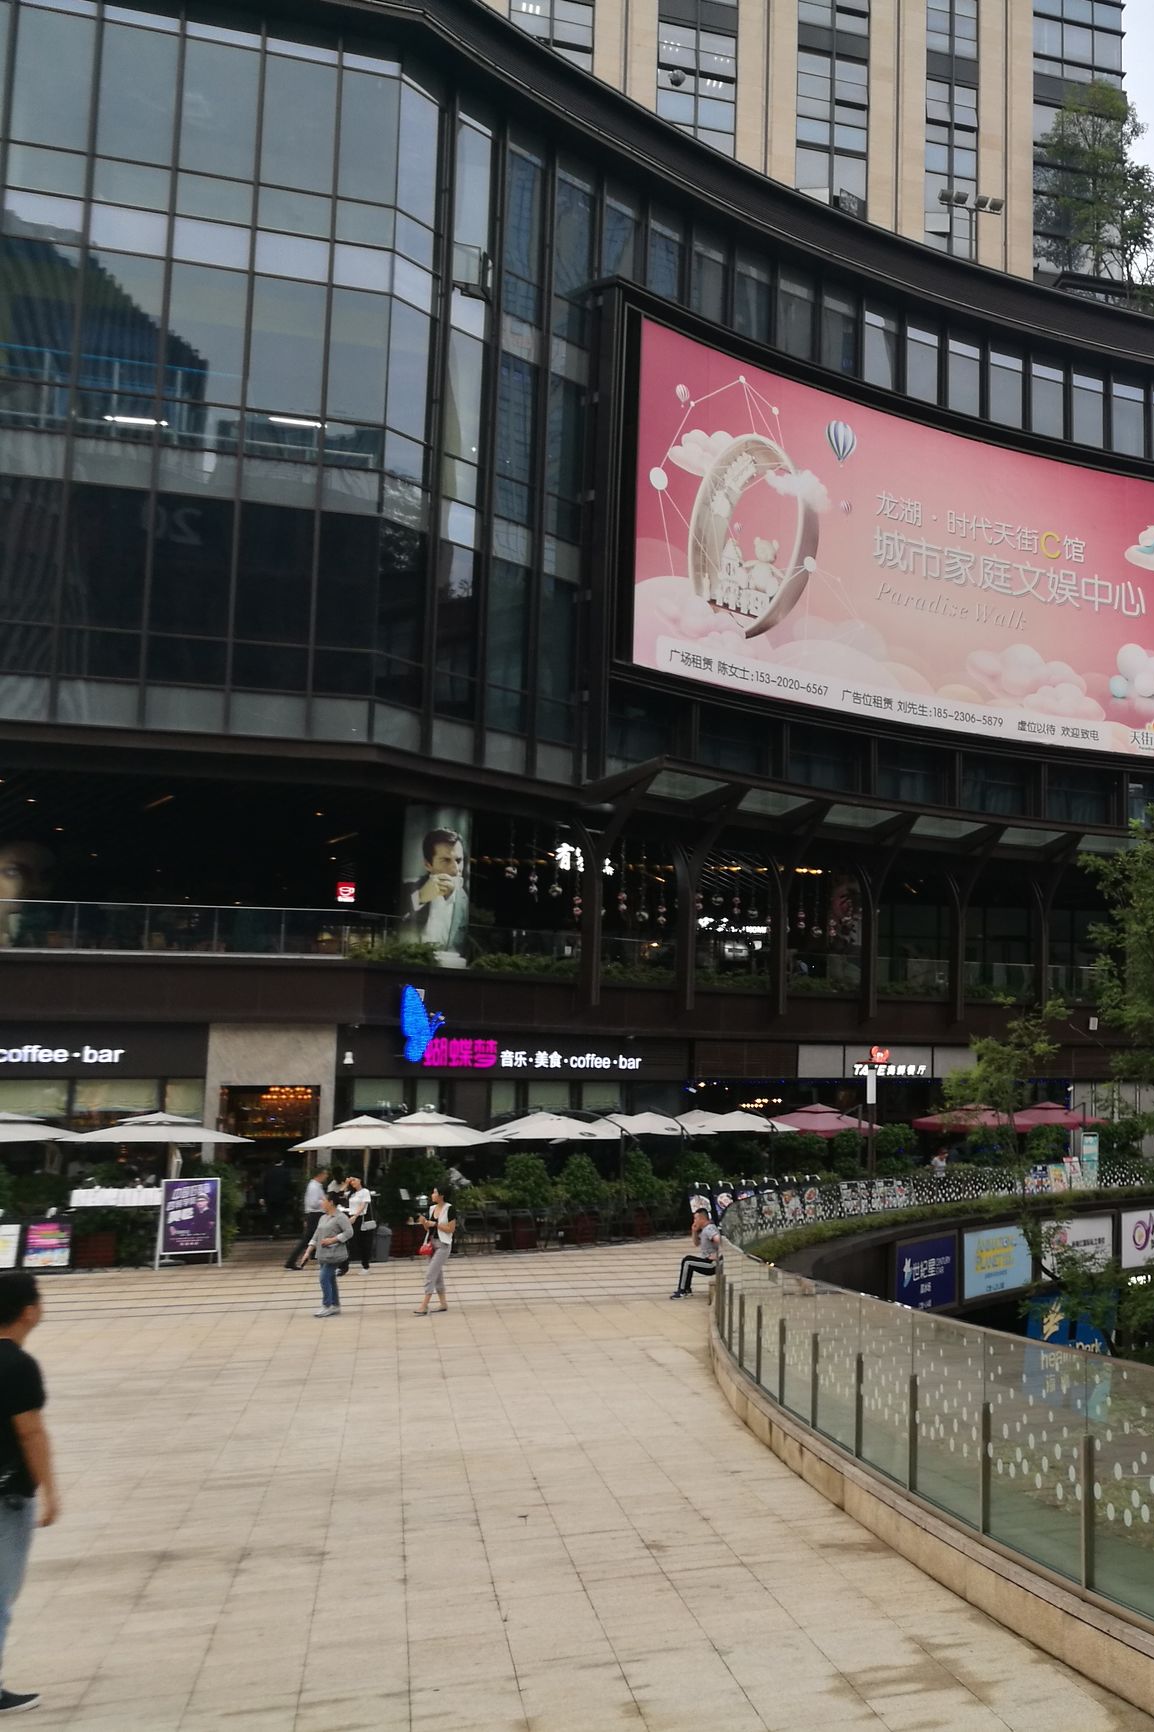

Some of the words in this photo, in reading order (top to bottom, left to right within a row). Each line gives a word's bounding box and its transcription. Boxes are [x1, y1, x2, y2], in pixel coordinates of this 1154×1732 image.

[873, 526, 1146, 618] 城市家庭文娱中心
[874, 582, 969, 621] Paradise
[975, 602, 1028, 632] Walk
[669, 649, 713, 672] 广场租赁
[841, 689, 893, 712] 广告位租赁
[1060, 725, 1100, 742] 欢迎致电
[912, 1258, 935, 1281] 世纪星
